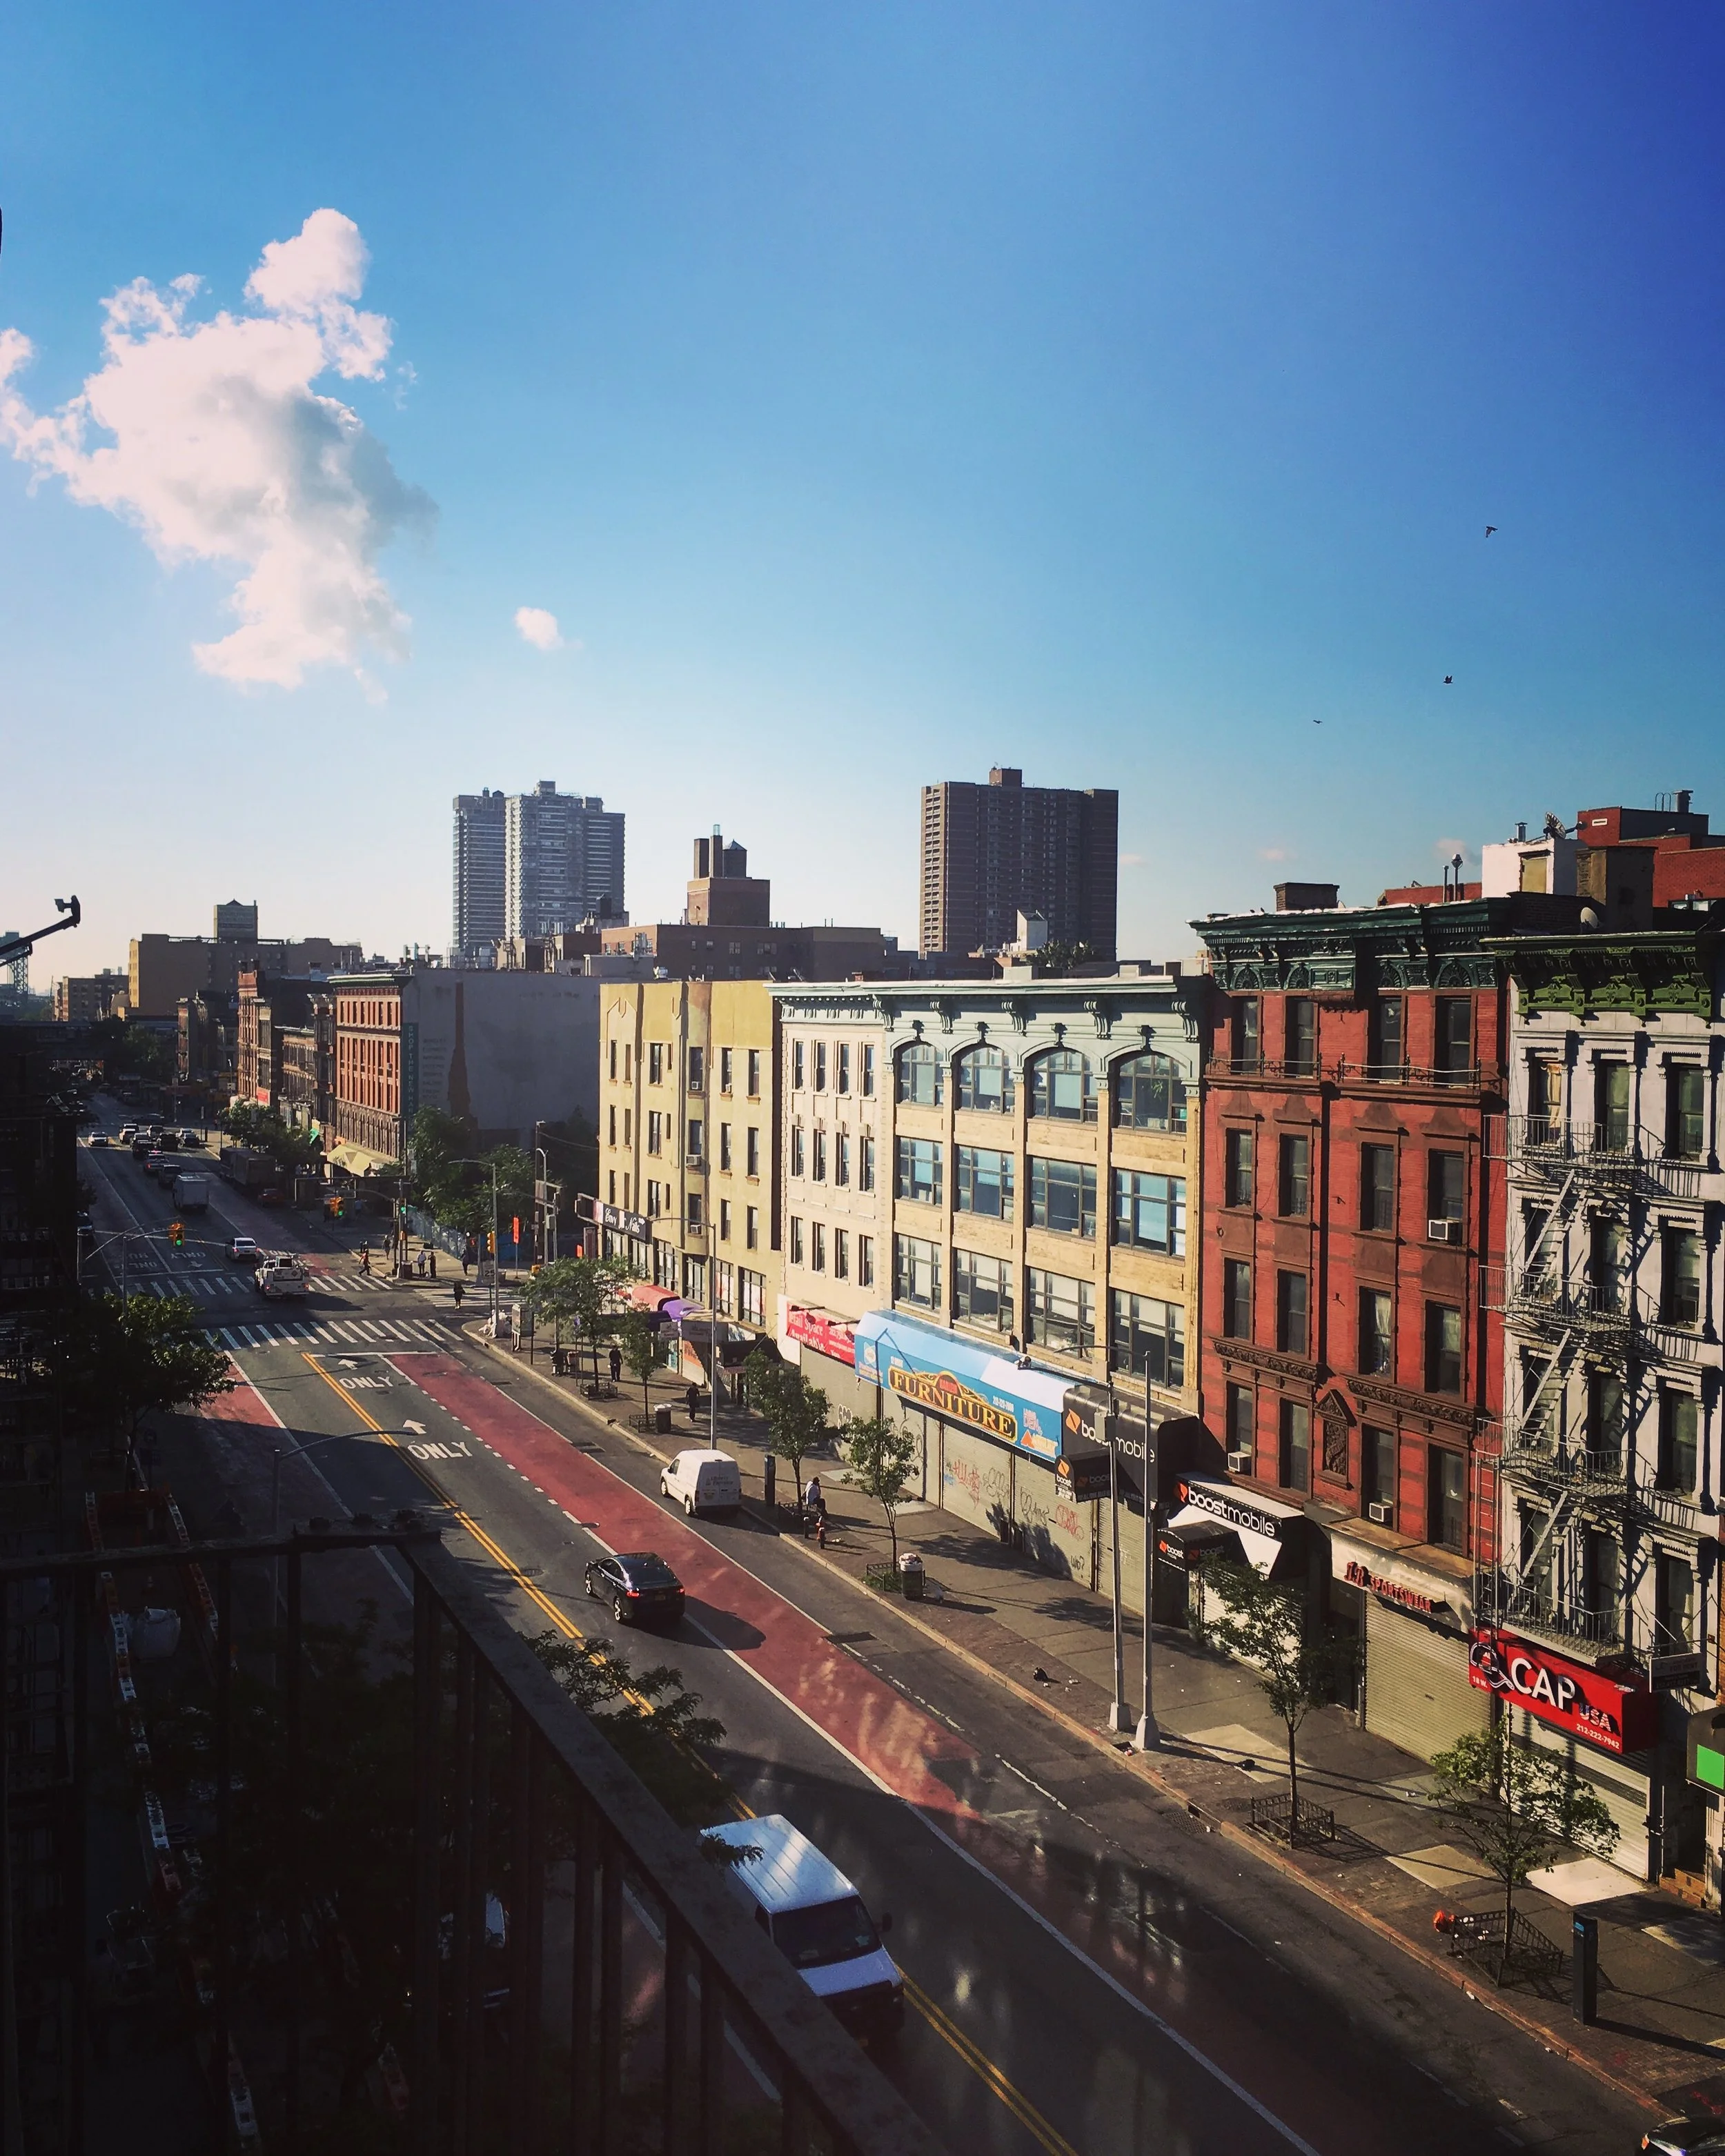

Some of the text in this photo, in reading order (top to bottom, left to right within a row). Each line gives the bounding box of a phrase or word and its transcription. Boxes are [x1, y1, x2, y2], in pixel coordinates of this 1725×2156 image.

[171, 1252, 206, 1260] ONLY
[339, 1376, 394, 1389] ONLY
[894, 1371, 1012, 1436] FURNITURE
[407, 1441, 473, 1460] ONLY
[1056, 1474, 1072, 1488] boost
[1167, 1543, 1184, 1559] boost
[1370, 1576, 1432, 1614] SPORTSWEAR
[1510, 1657, 1576, 1710] CAP
[1579, 1703, 1613, 1732] USA
[1576, 1723, 1621, 1750] 212-222-7942
